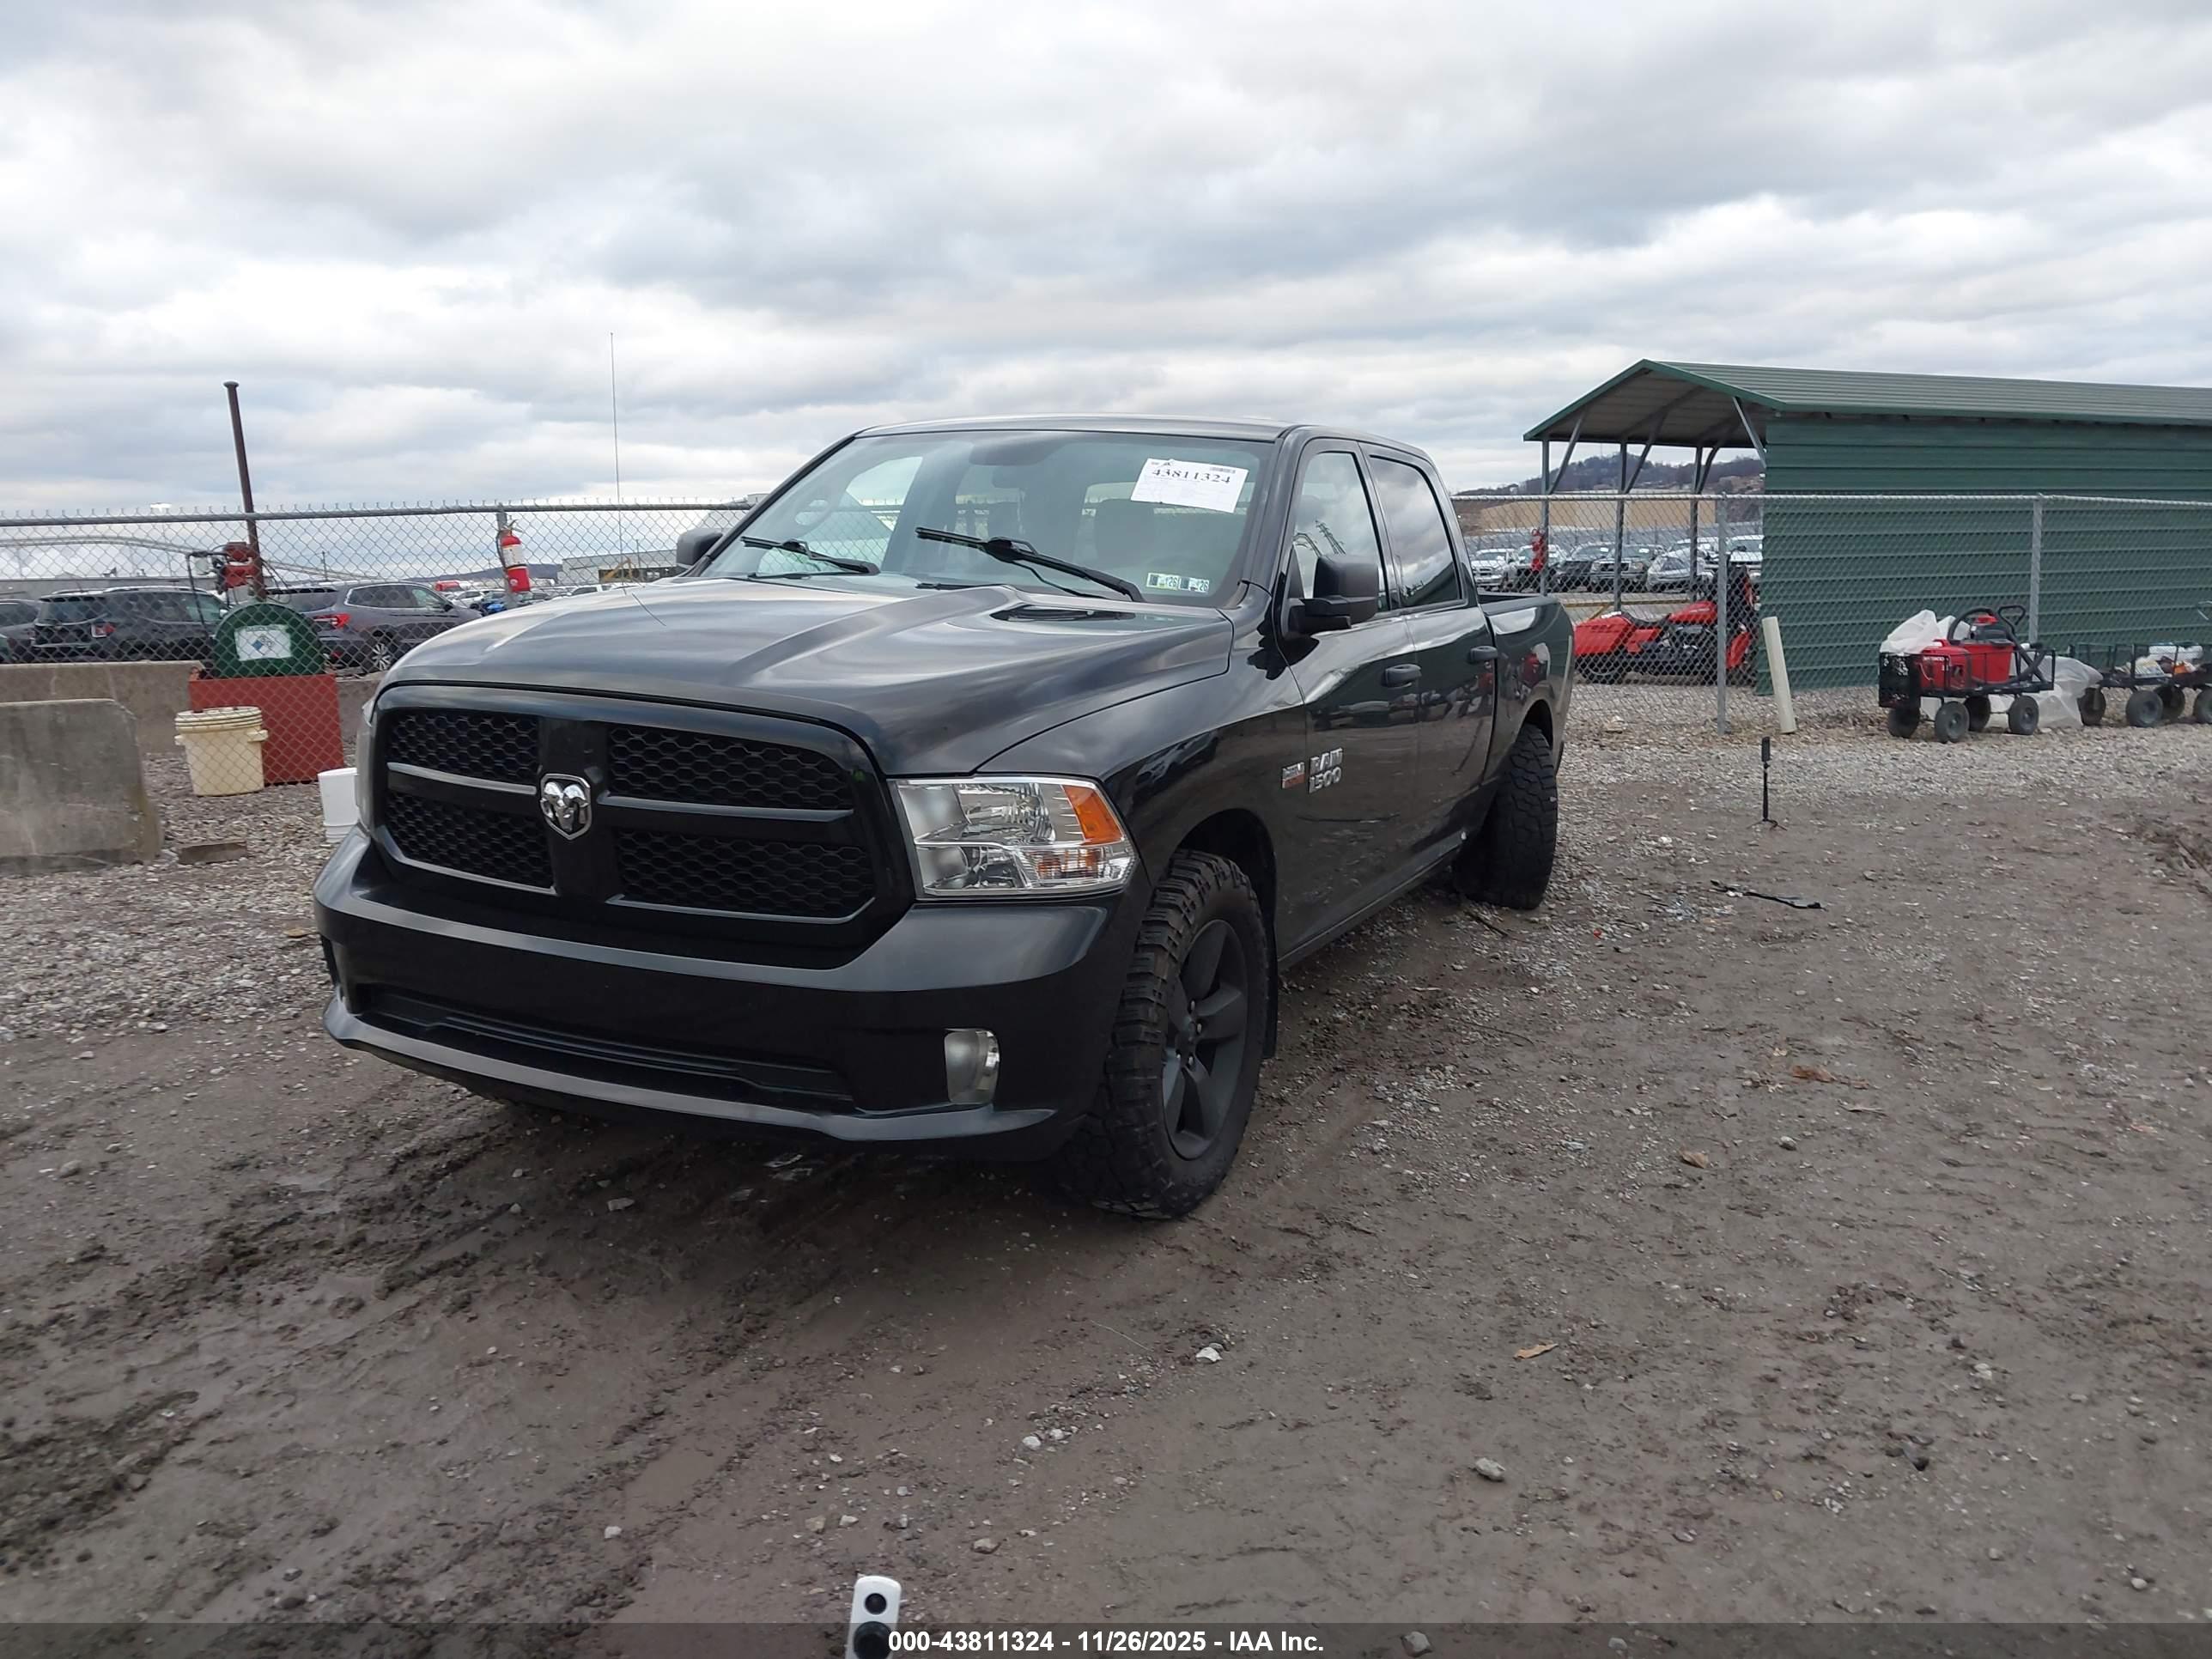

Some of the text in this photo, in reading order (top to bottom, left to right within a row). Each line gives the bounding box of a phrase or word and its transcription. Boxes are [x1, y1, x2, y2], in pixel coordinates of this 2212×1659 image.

[1152, 469, 1231, 483] 43811324
[1310, 747, 1343, 775] RAM
[1309, 766, 1342, 793] 1500
